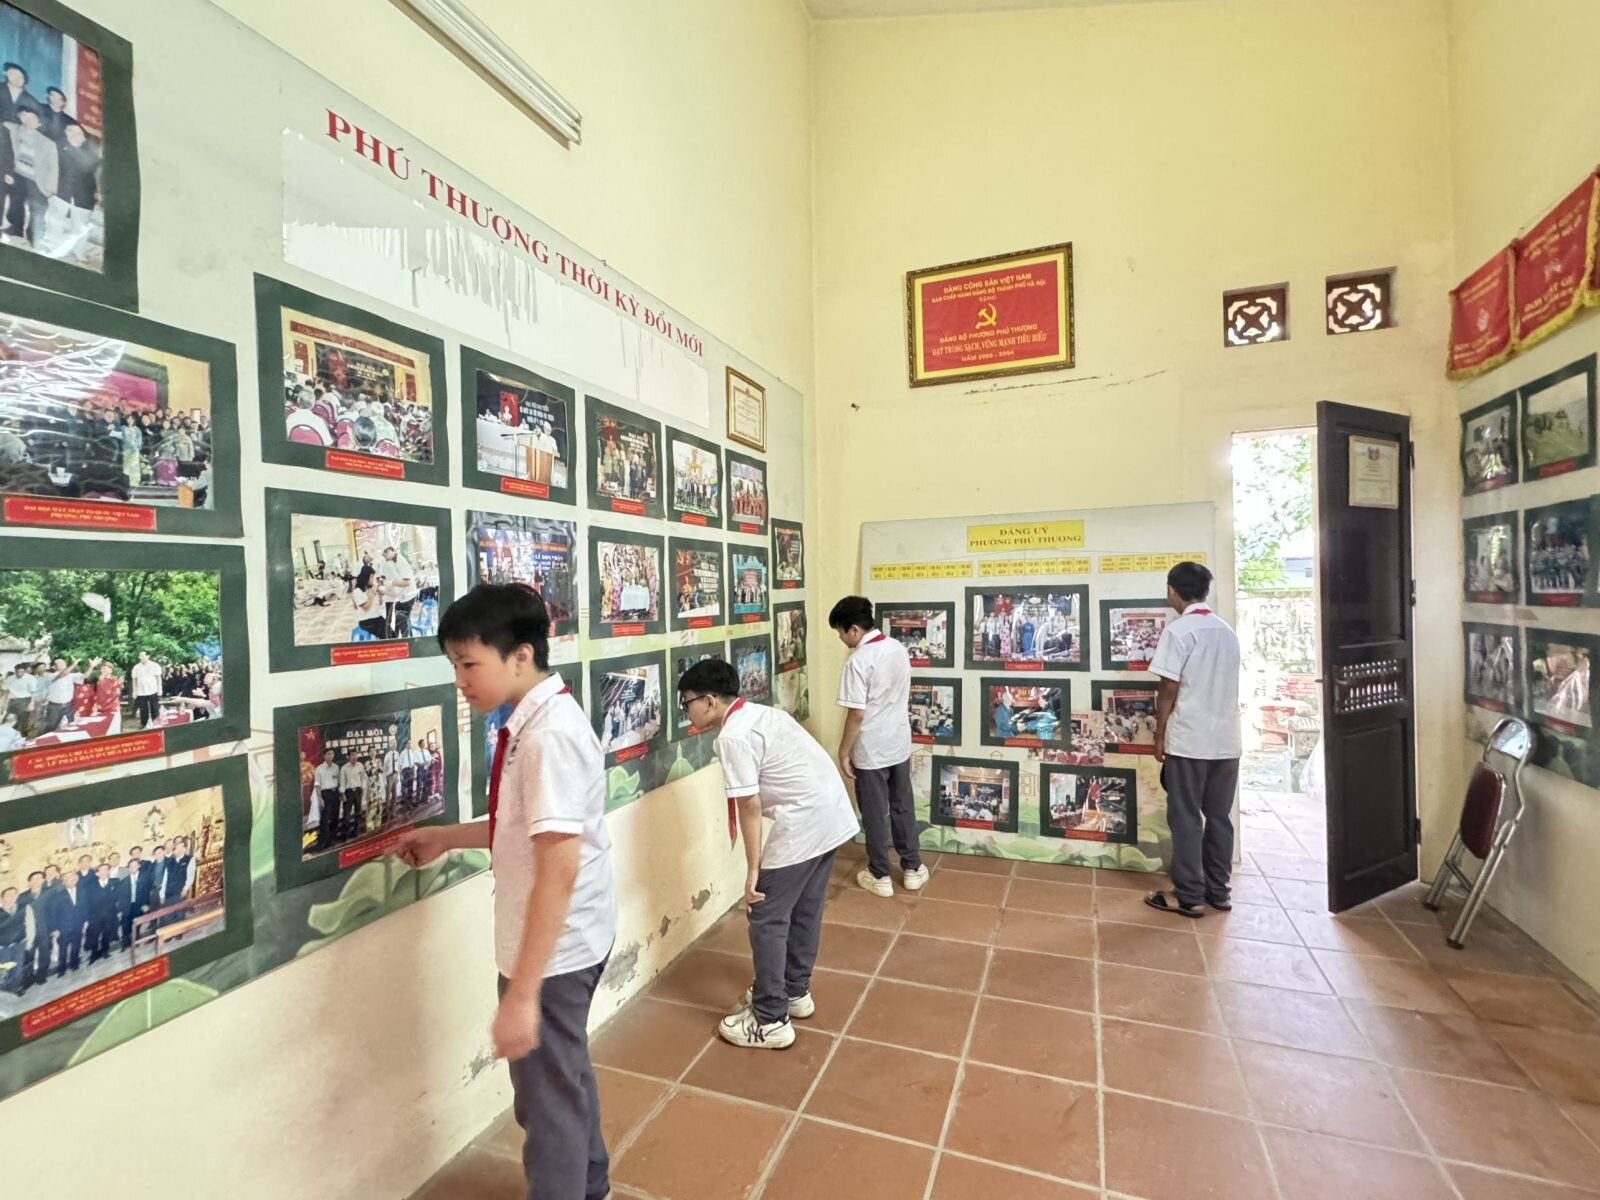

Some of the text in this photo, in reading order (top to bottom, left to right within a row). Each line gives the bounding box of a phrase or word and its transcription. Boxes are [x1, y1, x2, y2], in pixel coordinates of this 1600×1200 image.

[325, 108, 703, 357] PHÚ THƯỢNG THỜI KỲ ĐỔI MỚI
[963, 281, 983, 291] CÔNG
[984, 277, 999, 286] SẢN
[999, 275, 1014, 285] VIỆT
[1015, 273, 1032, 281] NAM
[1011, 323, 1038, 333] THƯỢNG
